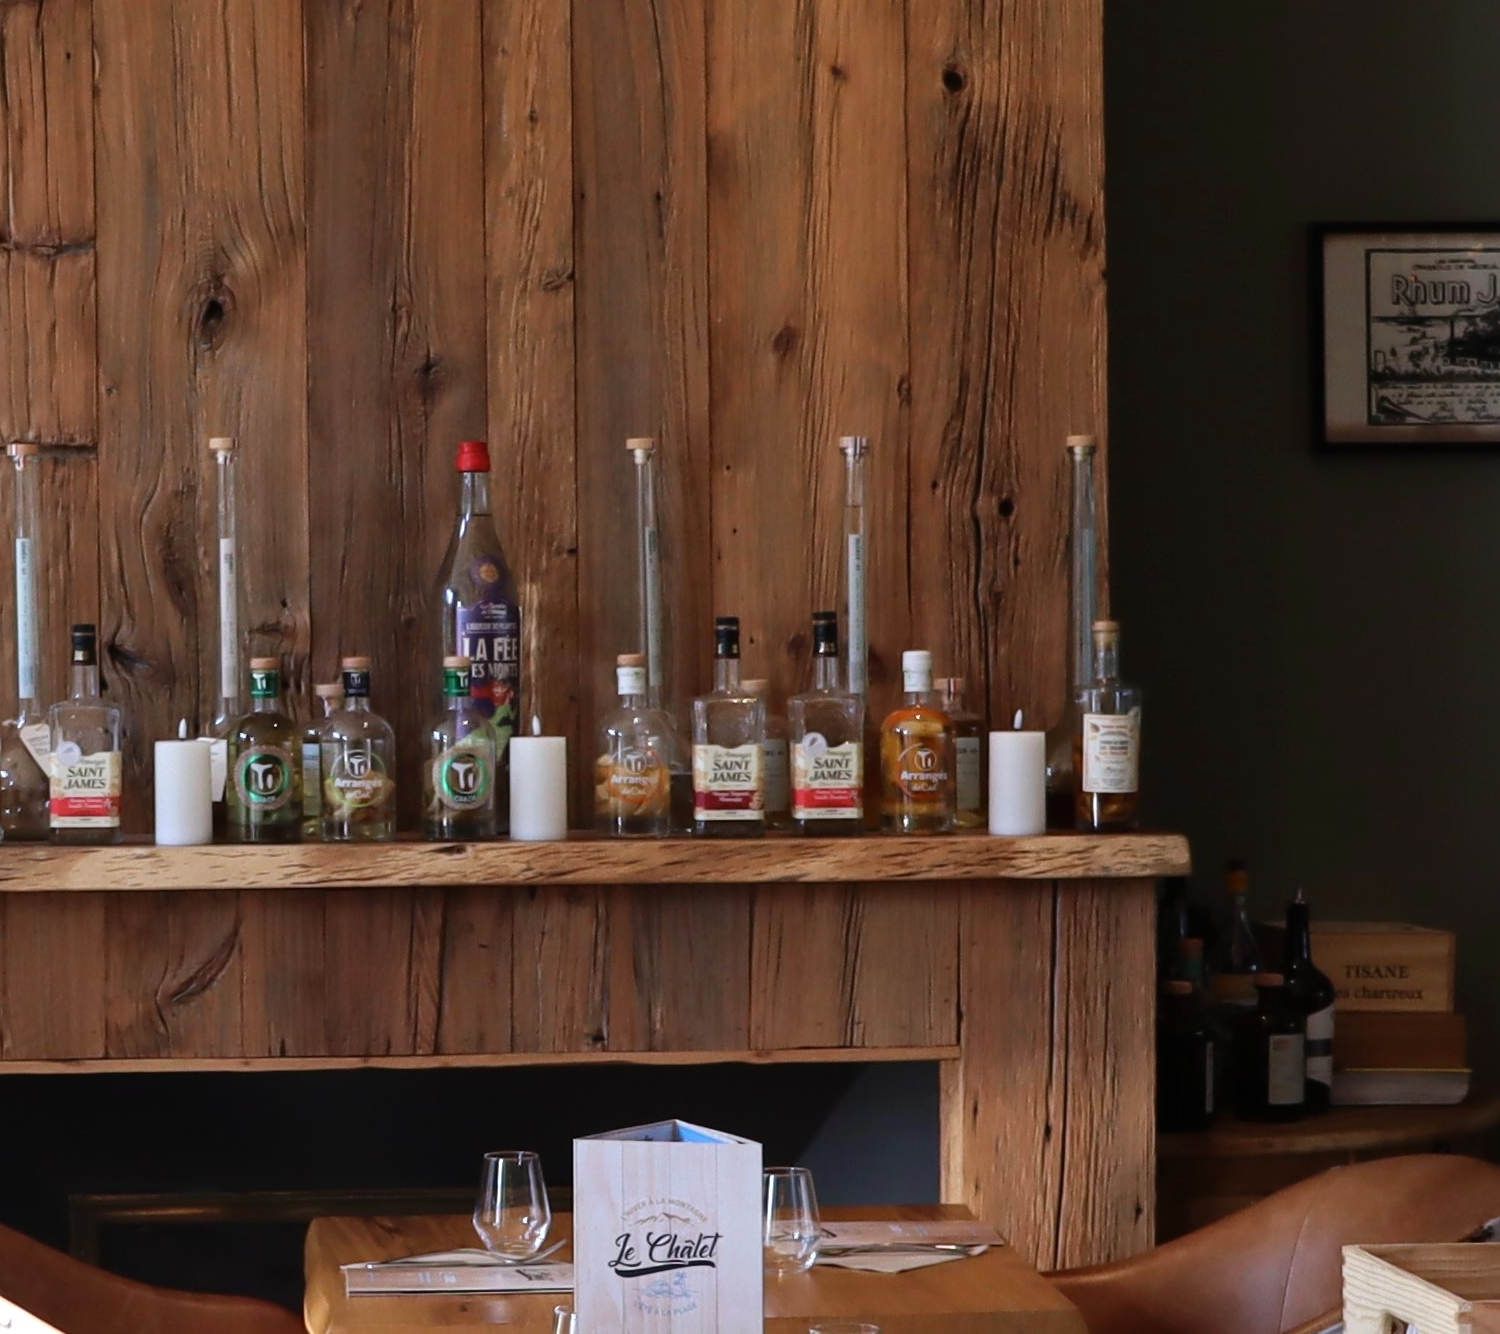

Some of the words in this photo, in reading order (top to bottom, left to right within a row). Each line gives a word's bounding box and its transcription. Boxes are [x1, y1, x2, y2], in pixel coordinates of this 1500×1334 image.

[1391, 273, 1471, 306] Rhum
[463, 637, 488, 661] LA
[493, 634, 518, 662] FÉE
[471, 663, 486, 678] ES
[711, 759, 750, 771] SAINT
[812, 757, 851, 769] SAINT
[67, 767, 106, 778] SAINT
[708, 772, 752, 783] JAMES
[809, 770, 852, 781] JAMES
[63, 778, 106, 790] JAMES
[1345, 964, 1409, 979] TISANE
[1354, 985, 1423, 1000] chartreux
[608, 1232, 642, 1268] Le
[646, 1231, 723, 1263] Châlet
